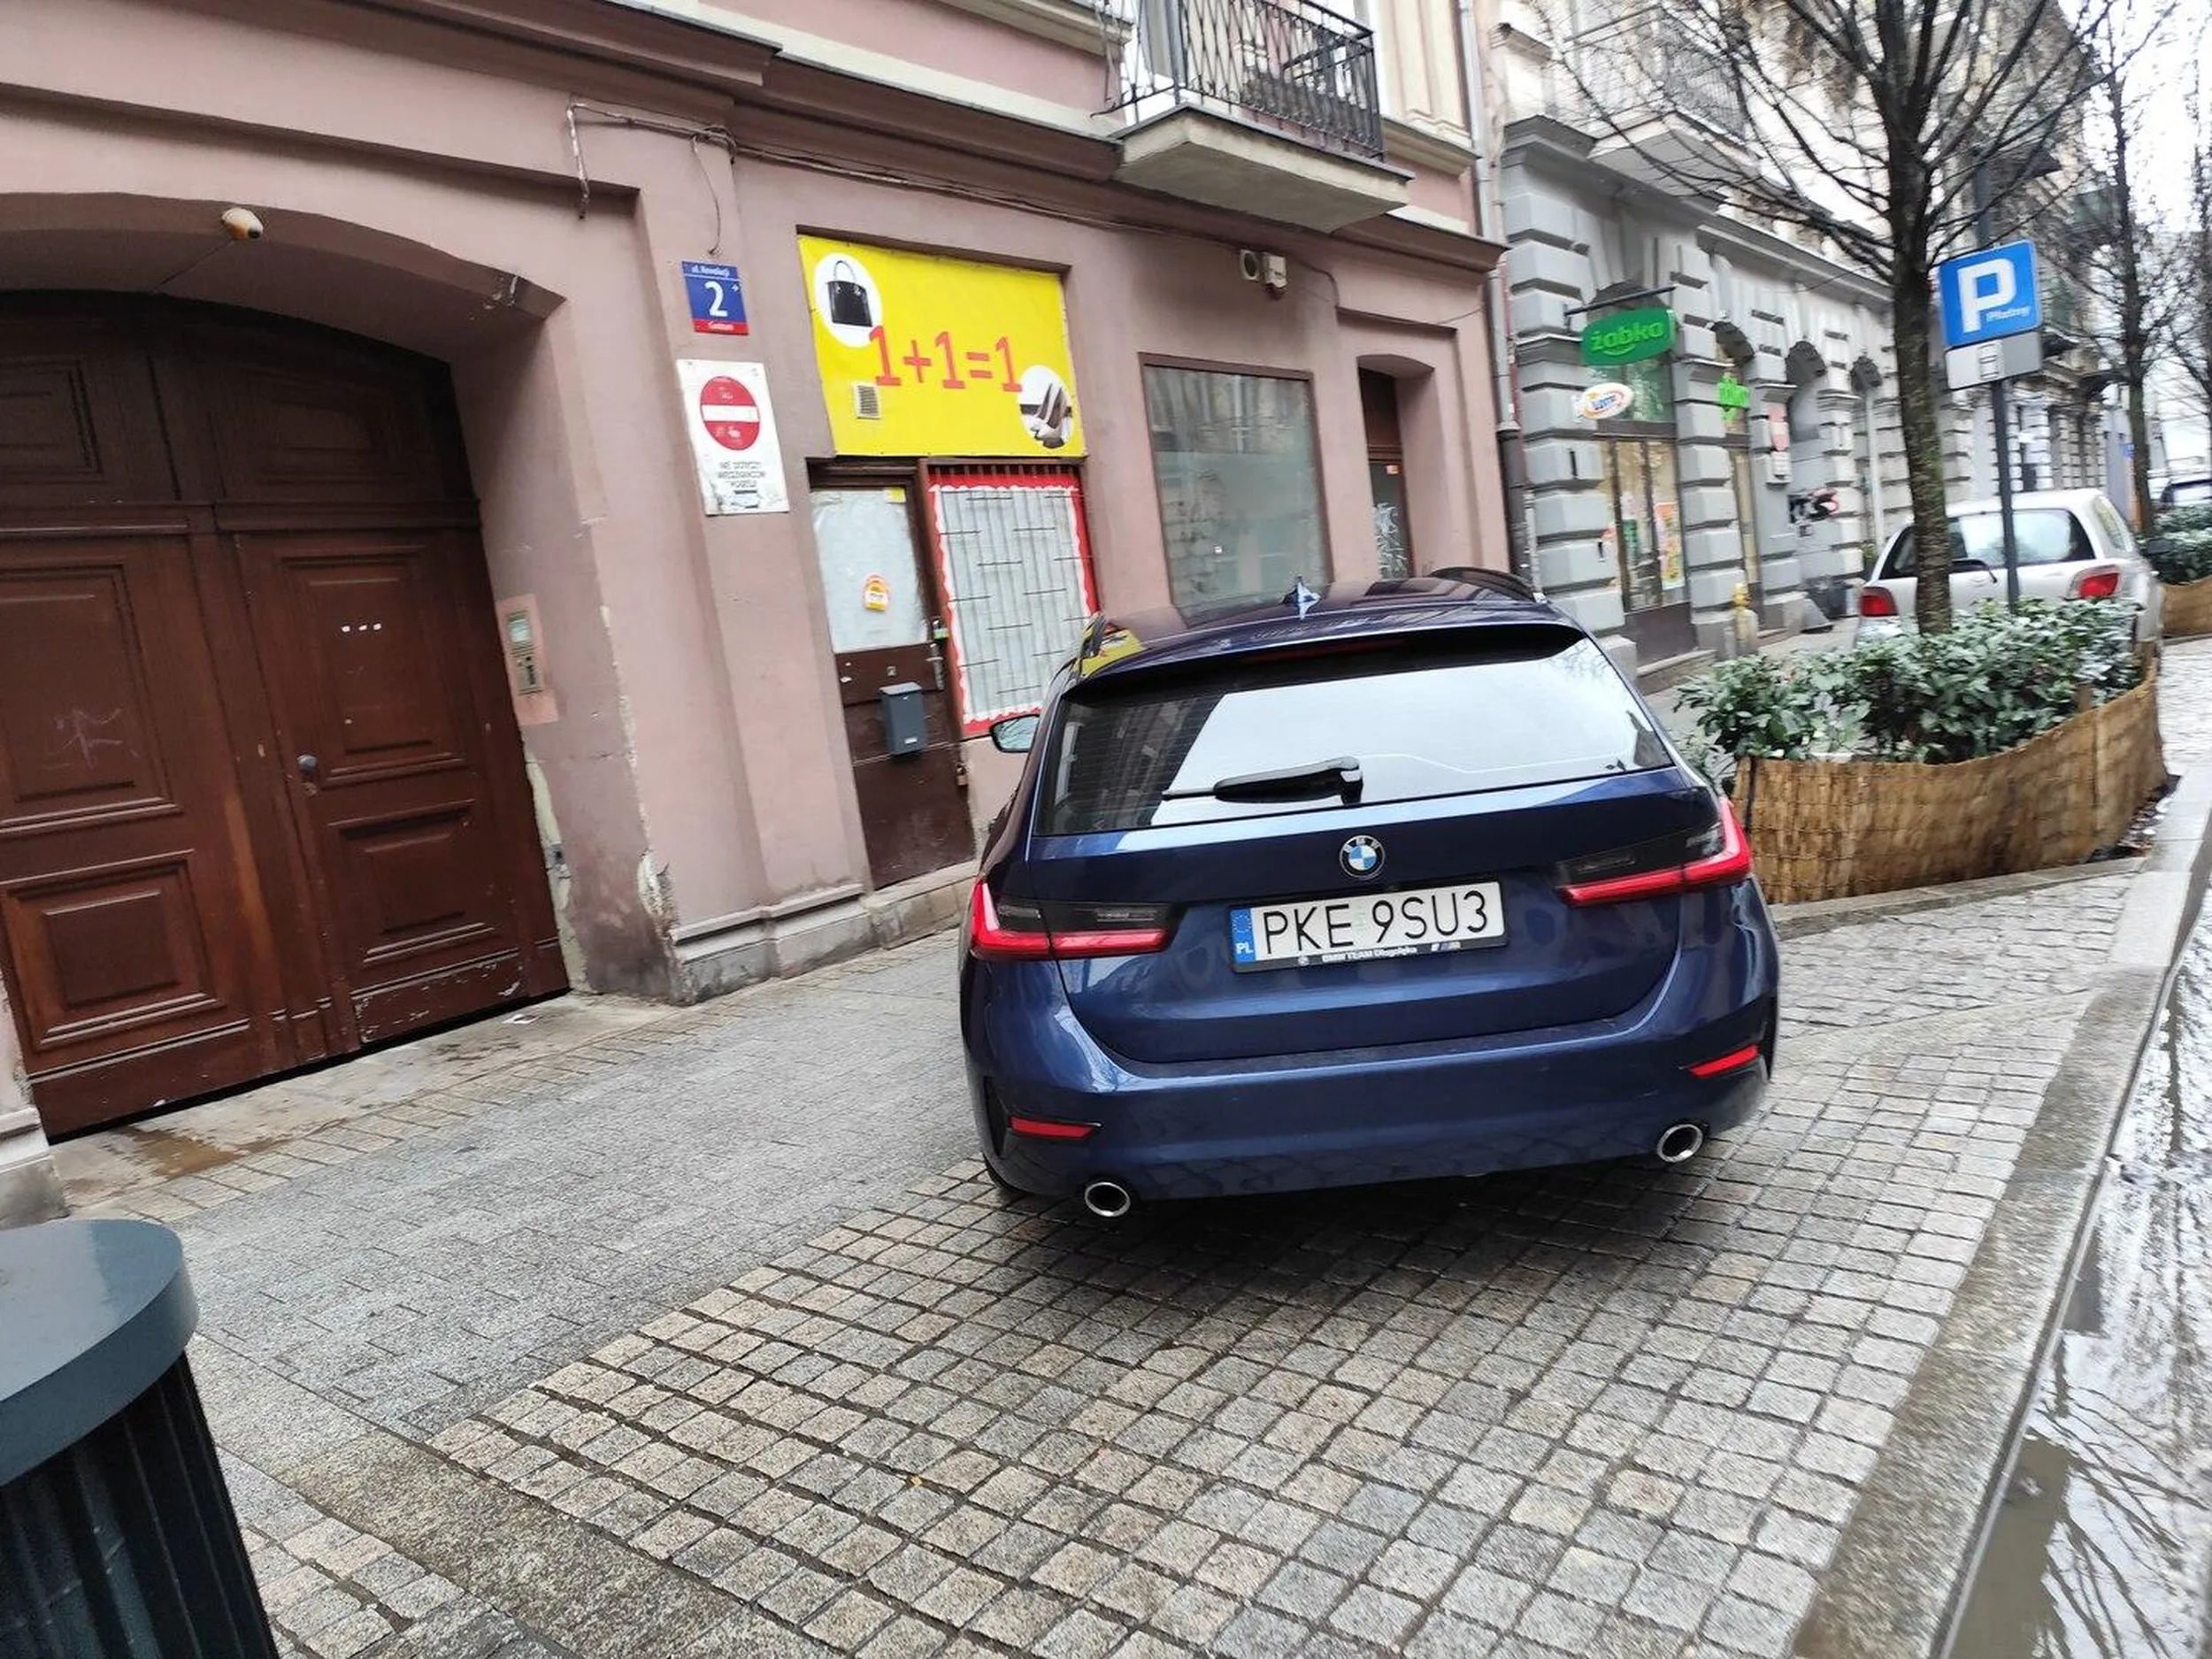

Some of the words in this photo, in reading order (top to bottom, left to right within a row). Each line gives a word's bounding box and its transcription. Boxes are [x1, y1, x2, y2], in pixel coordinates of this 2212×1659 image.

[705, 280, 728, 317] 2
[1956, 258, 2016, 334] P
[869, 325, 1023, 393] 1+1=1
[1591, 321, 1664, 351] żabka
[1263, 903, 1354, 955] PKE
[1371, 889, 1488, 944] 9SU3
[1236, 941, 1254, 955] PL
